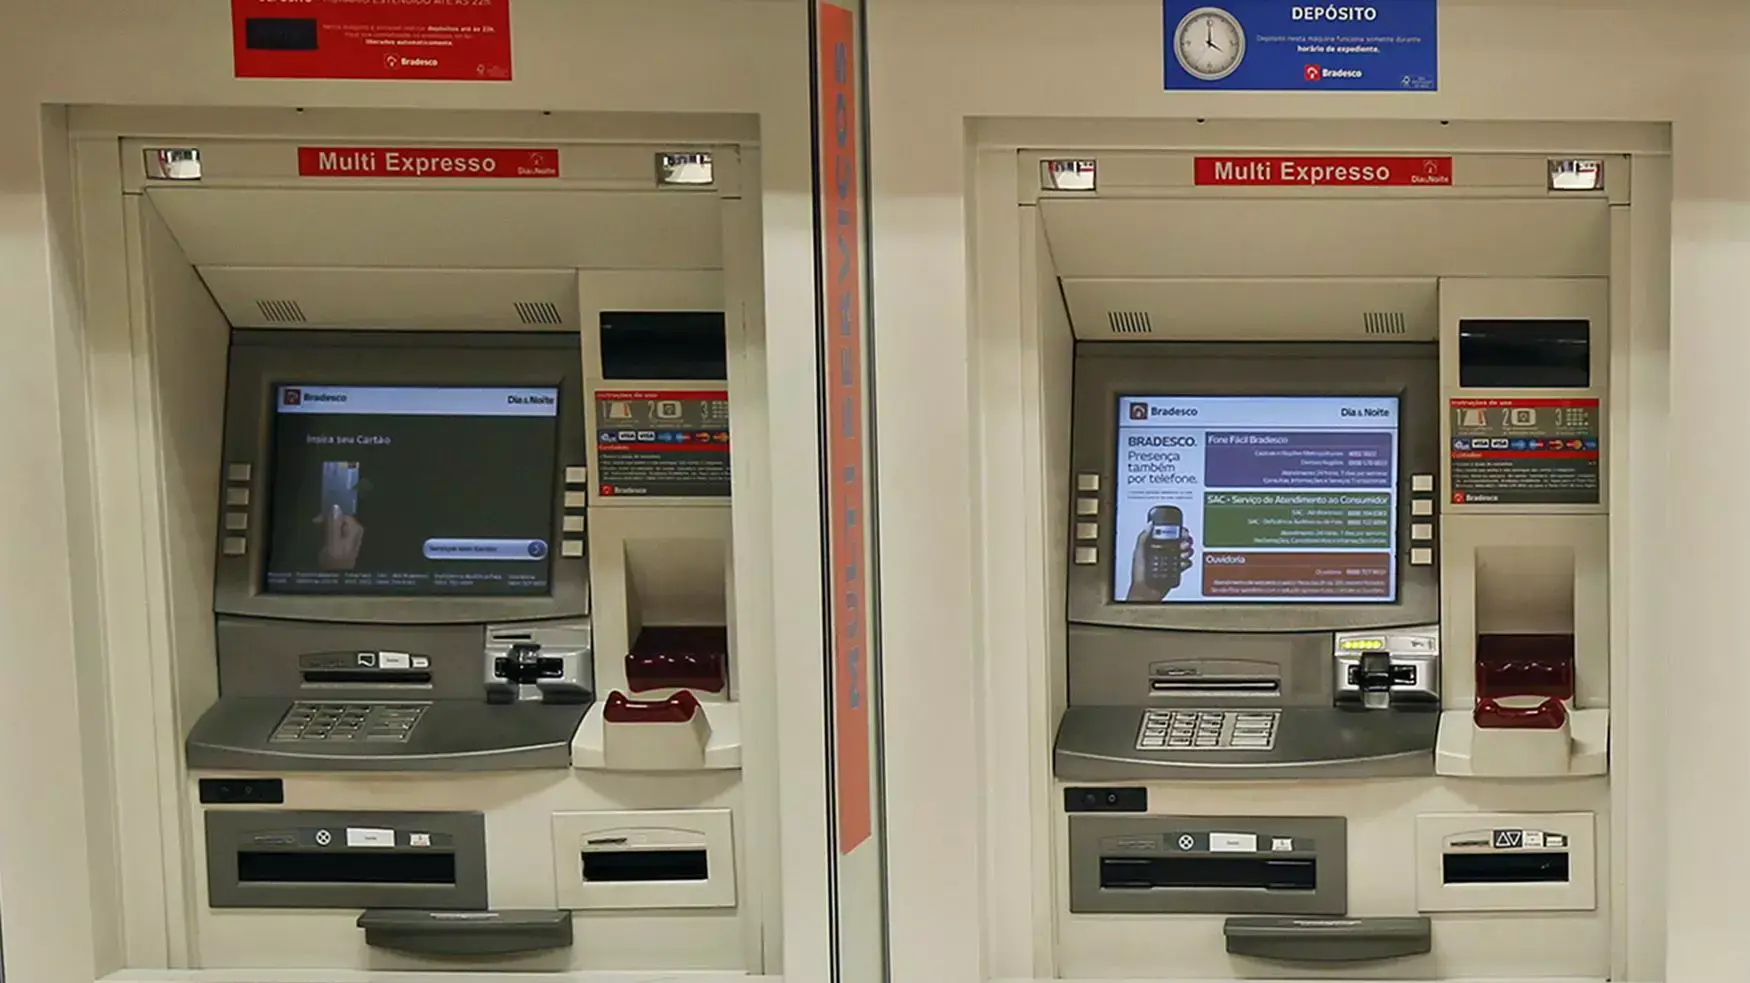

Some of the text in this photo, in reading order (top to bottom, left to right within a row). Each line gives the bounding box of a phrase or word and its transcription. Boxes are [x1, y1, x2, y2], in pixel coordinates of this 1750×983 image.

[1292, 5, 1377, 21] DEPÓSITO
[401, 57, 439, 67] Bradesco
[1322, 69, 1362, 78] Bradesco
[319, 152, 496, 175] Multi Expresso
[1215, 161, 1390, 184] Multi Expresso
[303, 392, 347, 403] Bradesco
[1151, 406, 1198, 416] Bradesco
[1341, 407, 1356, 417] Dia
[1364, 407, 1390, 417] Noite
[1555, 408, 1562, 426] 3
[307, 432, 392, 445] Insira seu Cartão
[1128, 436, 1198, 448] BRADESCO.
[1128, 450, 1180, 463] Presença
[1128, 462, 1176, 473] também
[1128, 475, 1146, 485] por
[1206, 554, 1246, 565] Ouvidoria
